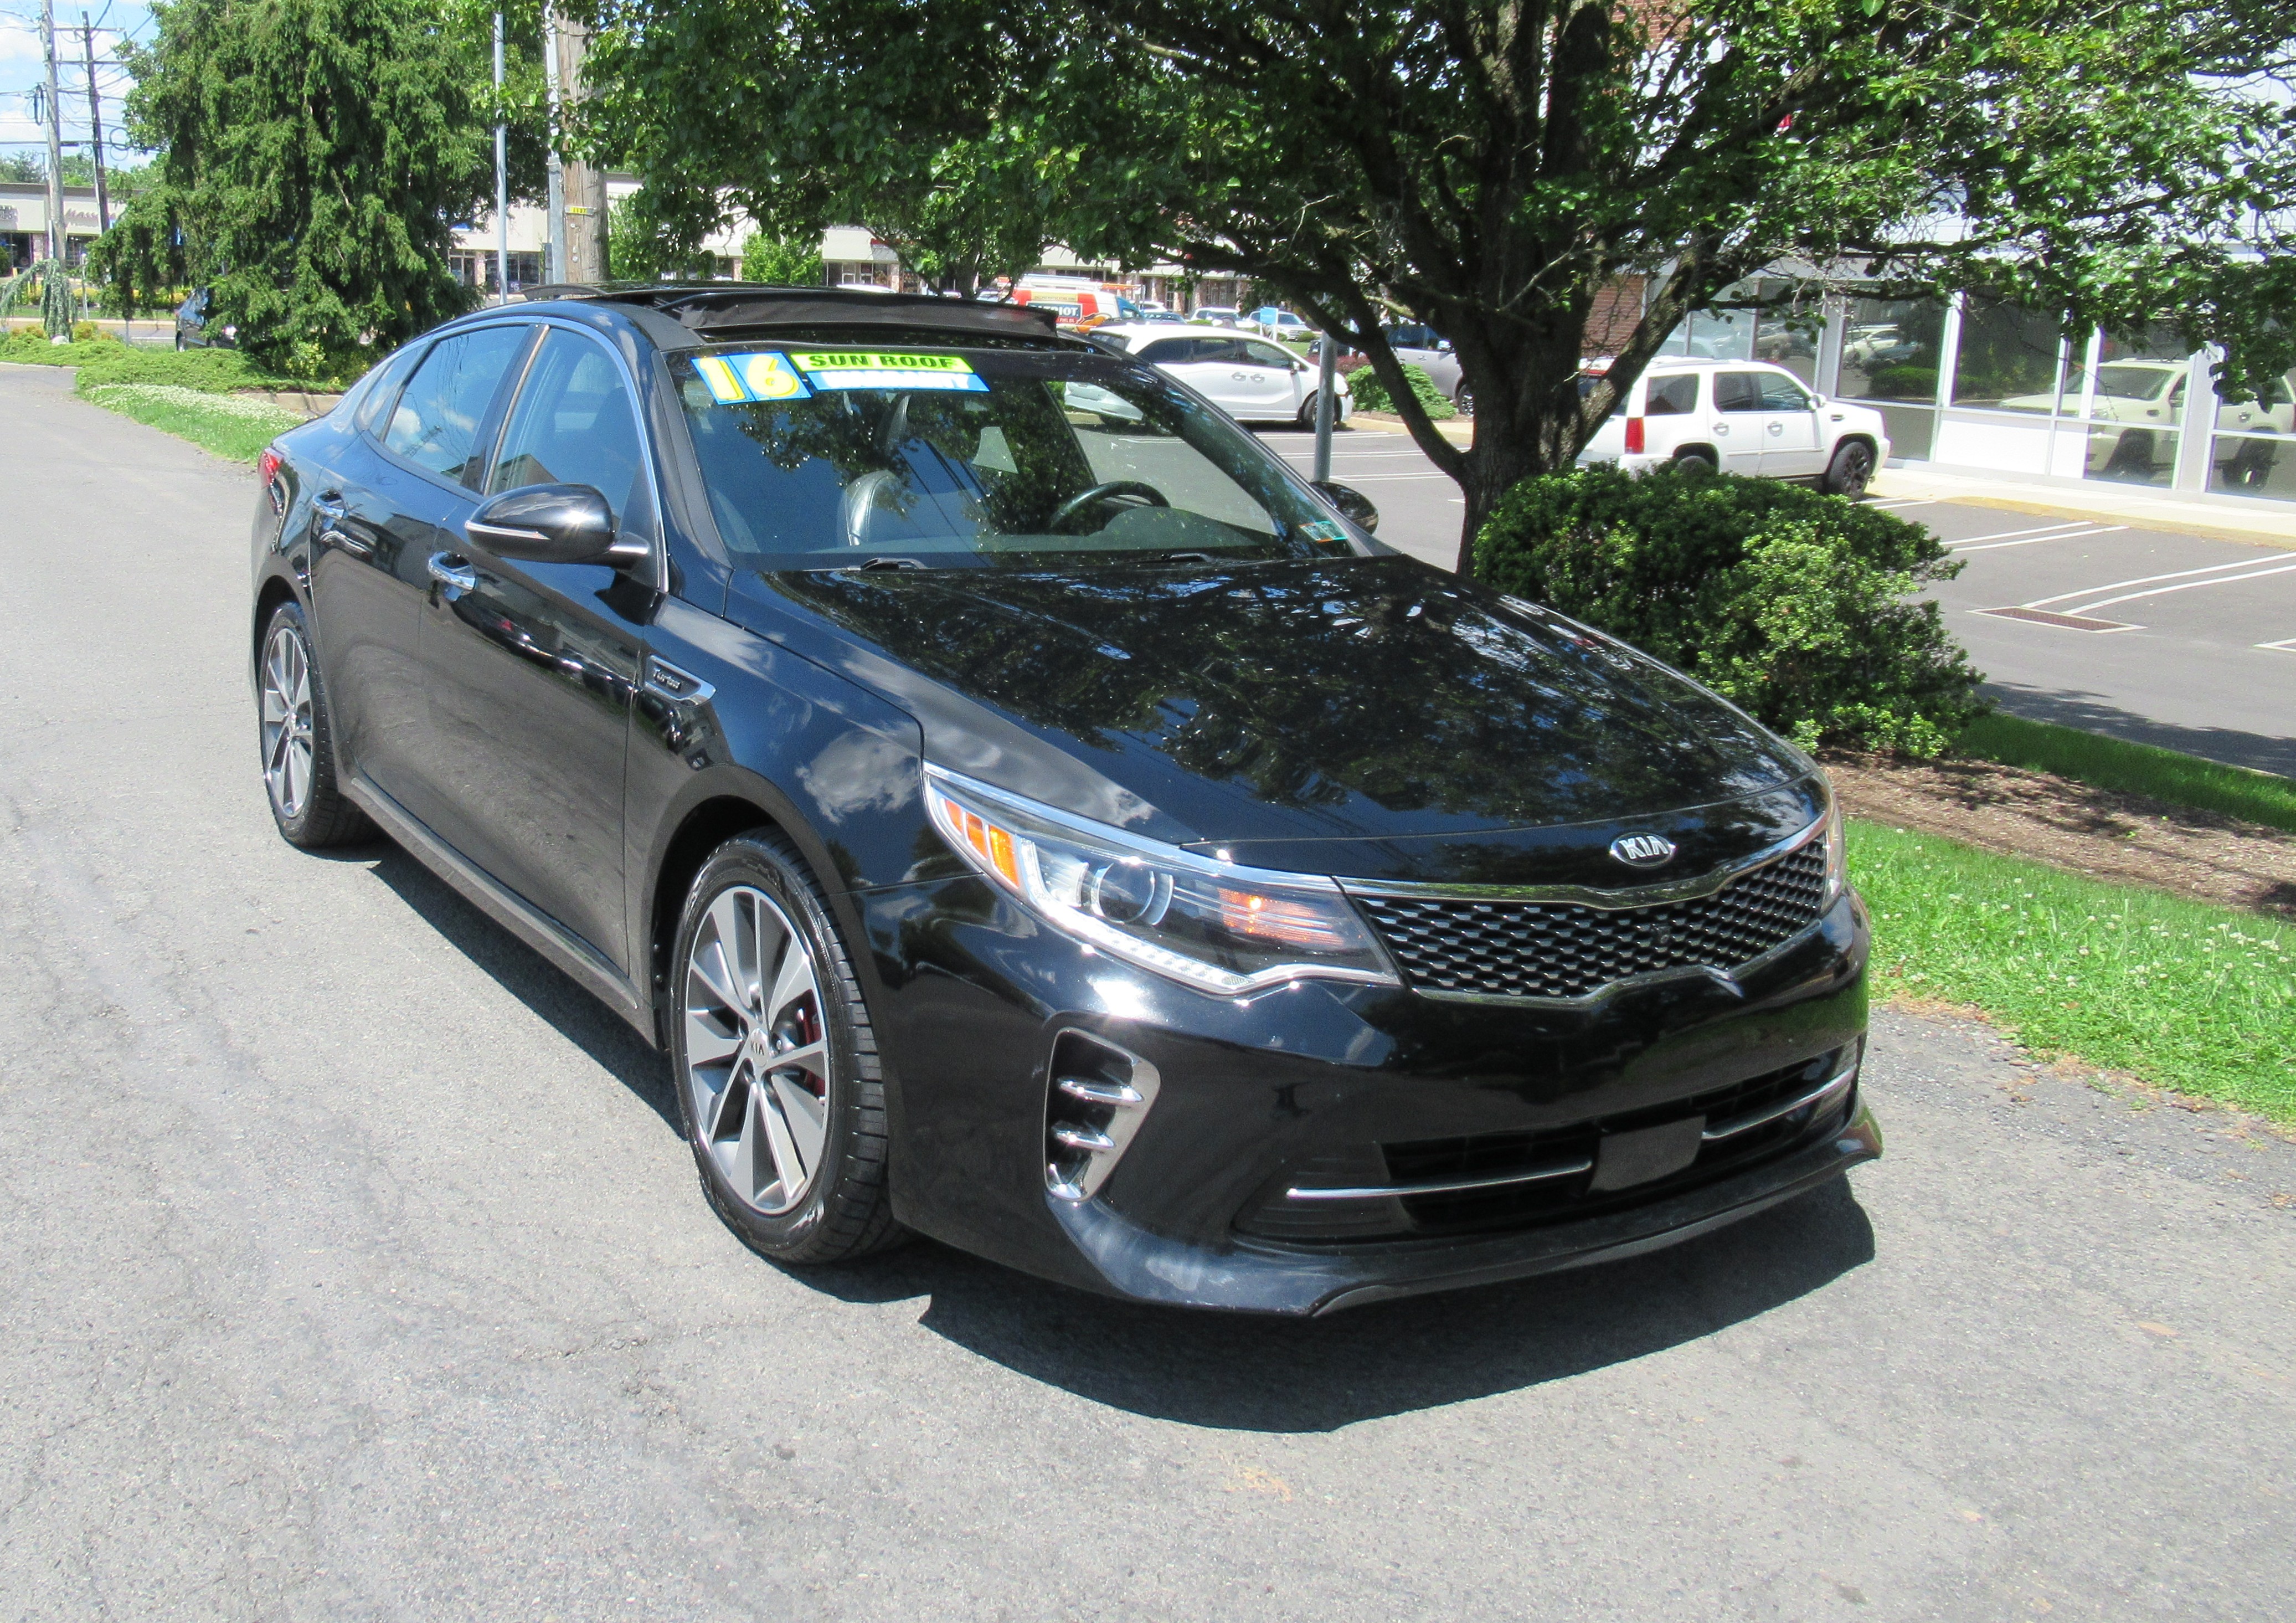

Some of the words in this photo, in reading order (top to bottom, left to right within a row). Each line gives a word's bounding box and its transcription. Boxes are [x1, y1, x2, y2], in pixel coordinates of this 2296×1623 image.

[809, 355, 867, 367] SUN
[878, 356, 957, 368] ROOF
[699, 355, 799, 400] 16
[1619, 835, 1669, 859] KIA
[750, 1041, 764, 1055] KIA
